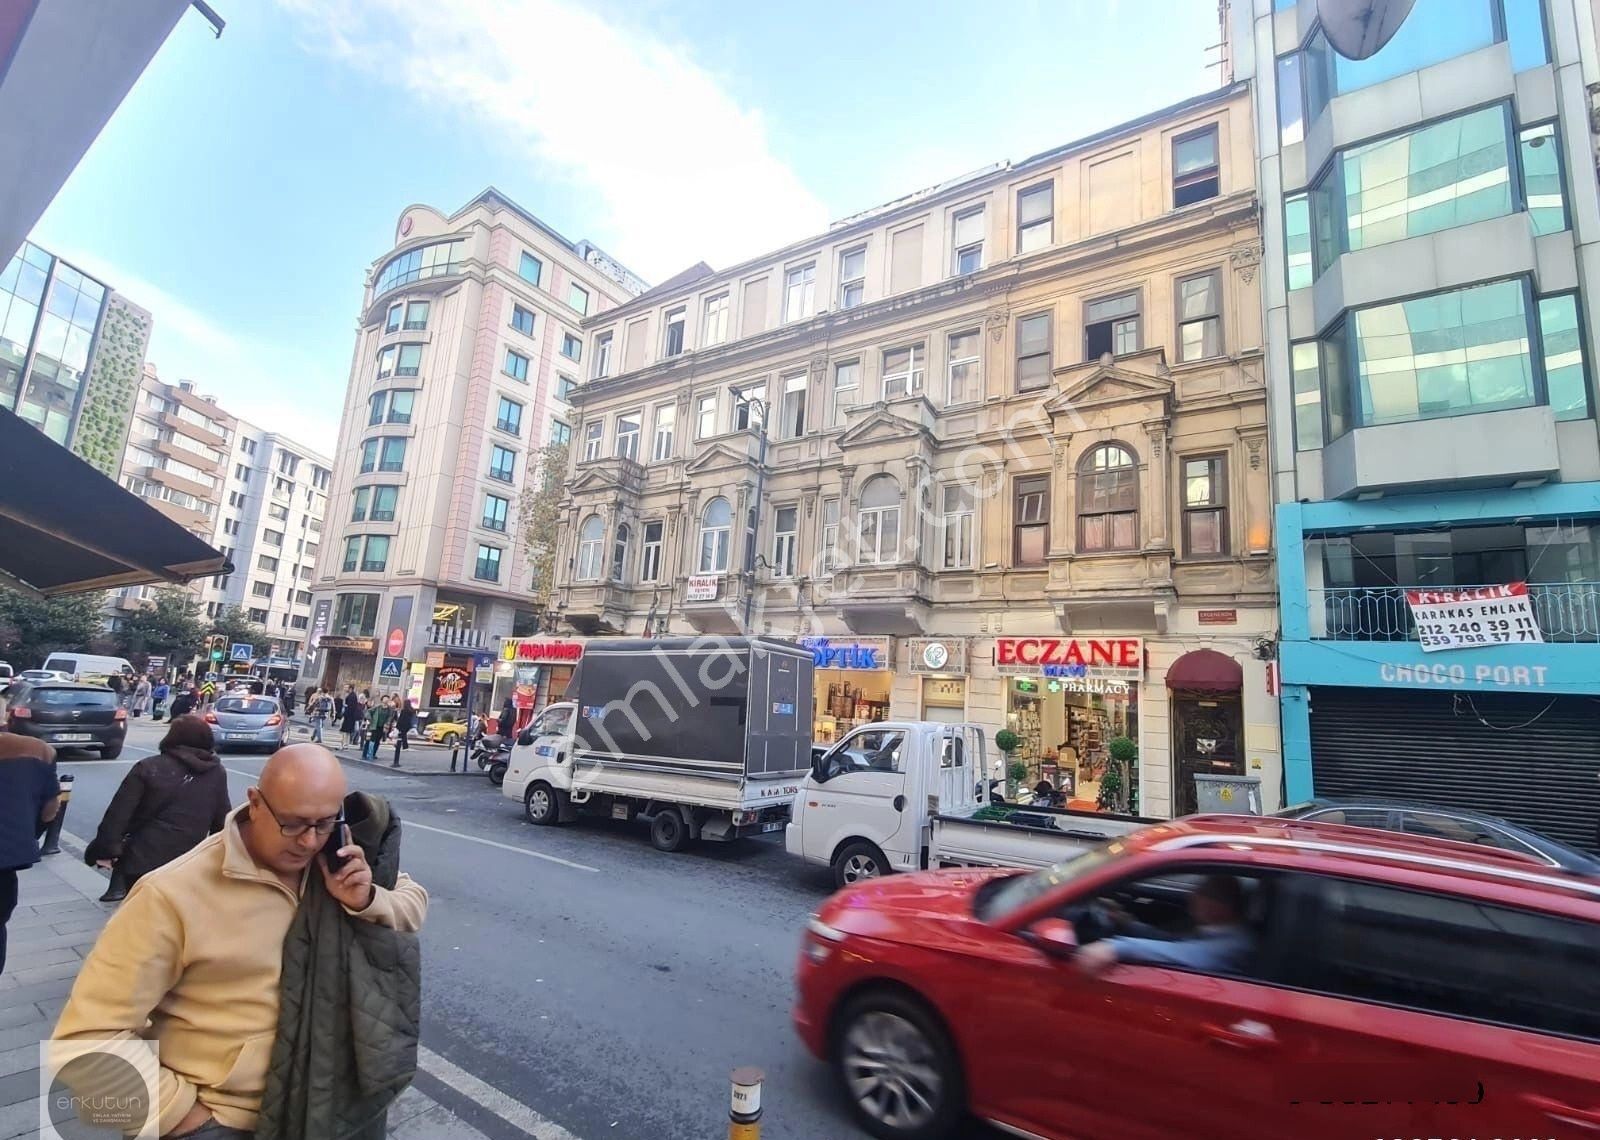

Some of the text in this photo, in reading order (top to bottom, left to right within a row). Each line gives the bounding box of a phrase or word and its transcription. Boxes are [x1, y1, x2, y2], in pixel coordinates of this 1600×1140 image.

[1481, 602, 1527, 616] EMLAK
[1419, 617, 1533, 635] 212 240 39 11
[1421, 629, 1537, 646] 539 798 37 71
[997, 639, 1140, 667] ECZANE
[1381, 663, 1548, 686] CHOCO PORT
[1062, 682, 1130, 694] PHARMACY
